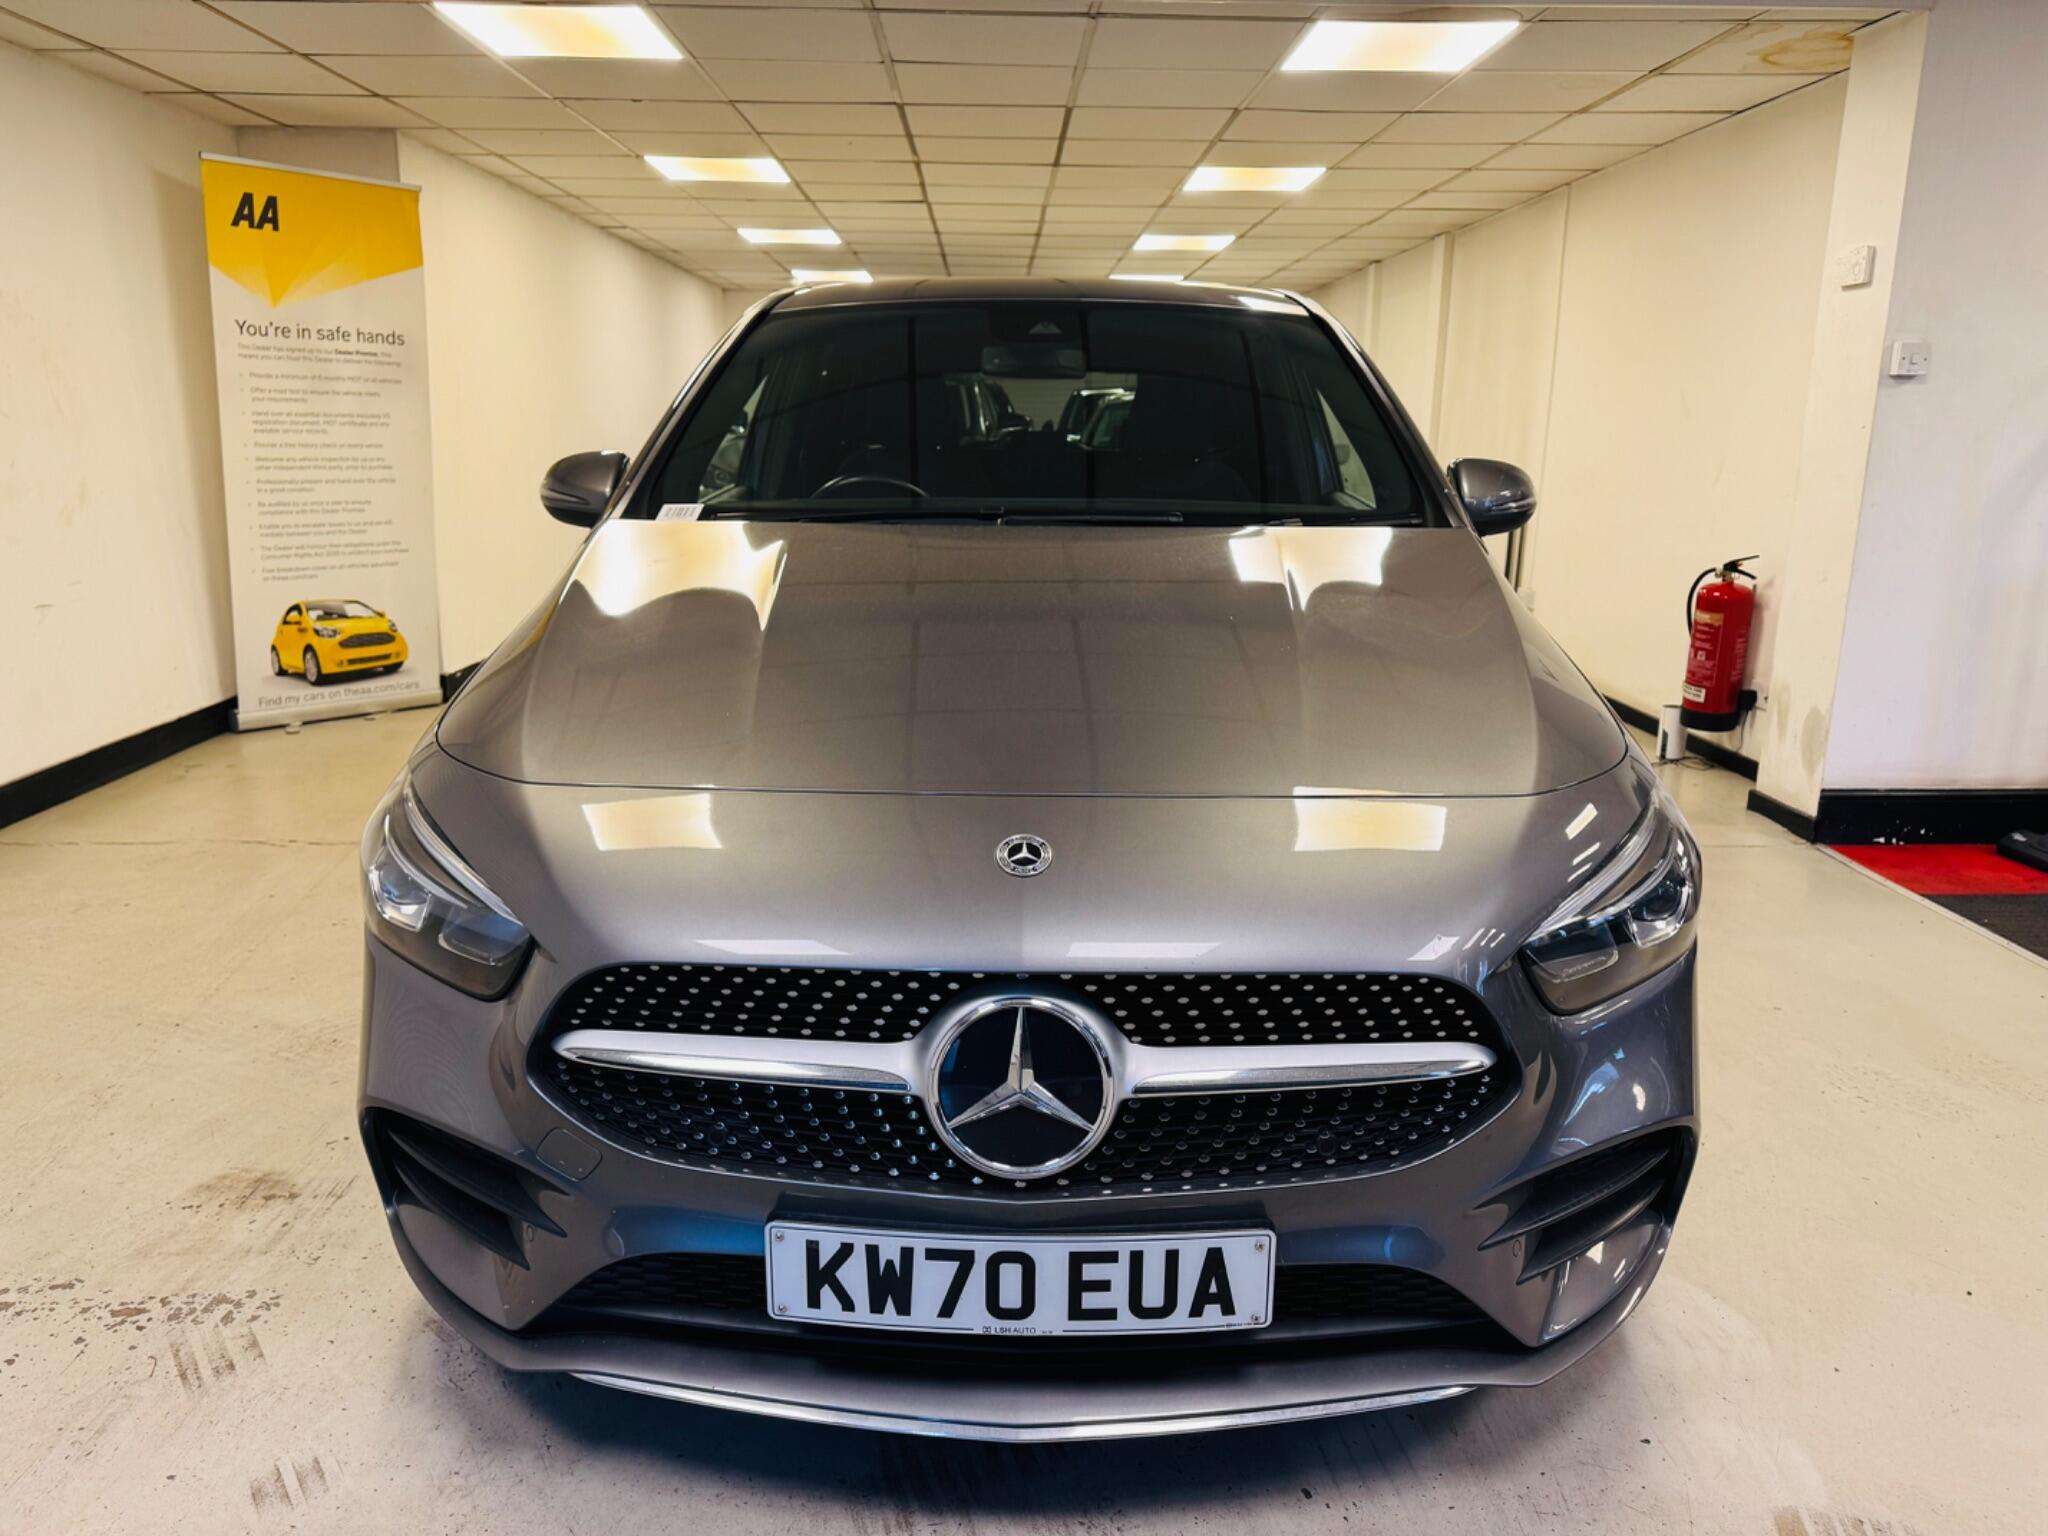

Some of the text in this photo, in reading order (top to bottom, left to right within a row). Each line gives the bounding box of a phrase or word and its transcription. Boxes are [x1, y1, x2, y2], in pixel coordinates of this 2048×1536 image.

[231, 192, 280, 232] AA
[235, 319, 406, 346] You're in safe hands
[258, 680, 421, 708] Find my cars on theaa.com/cars
[805, 1239, 1237, 1322] KW70 EUA
